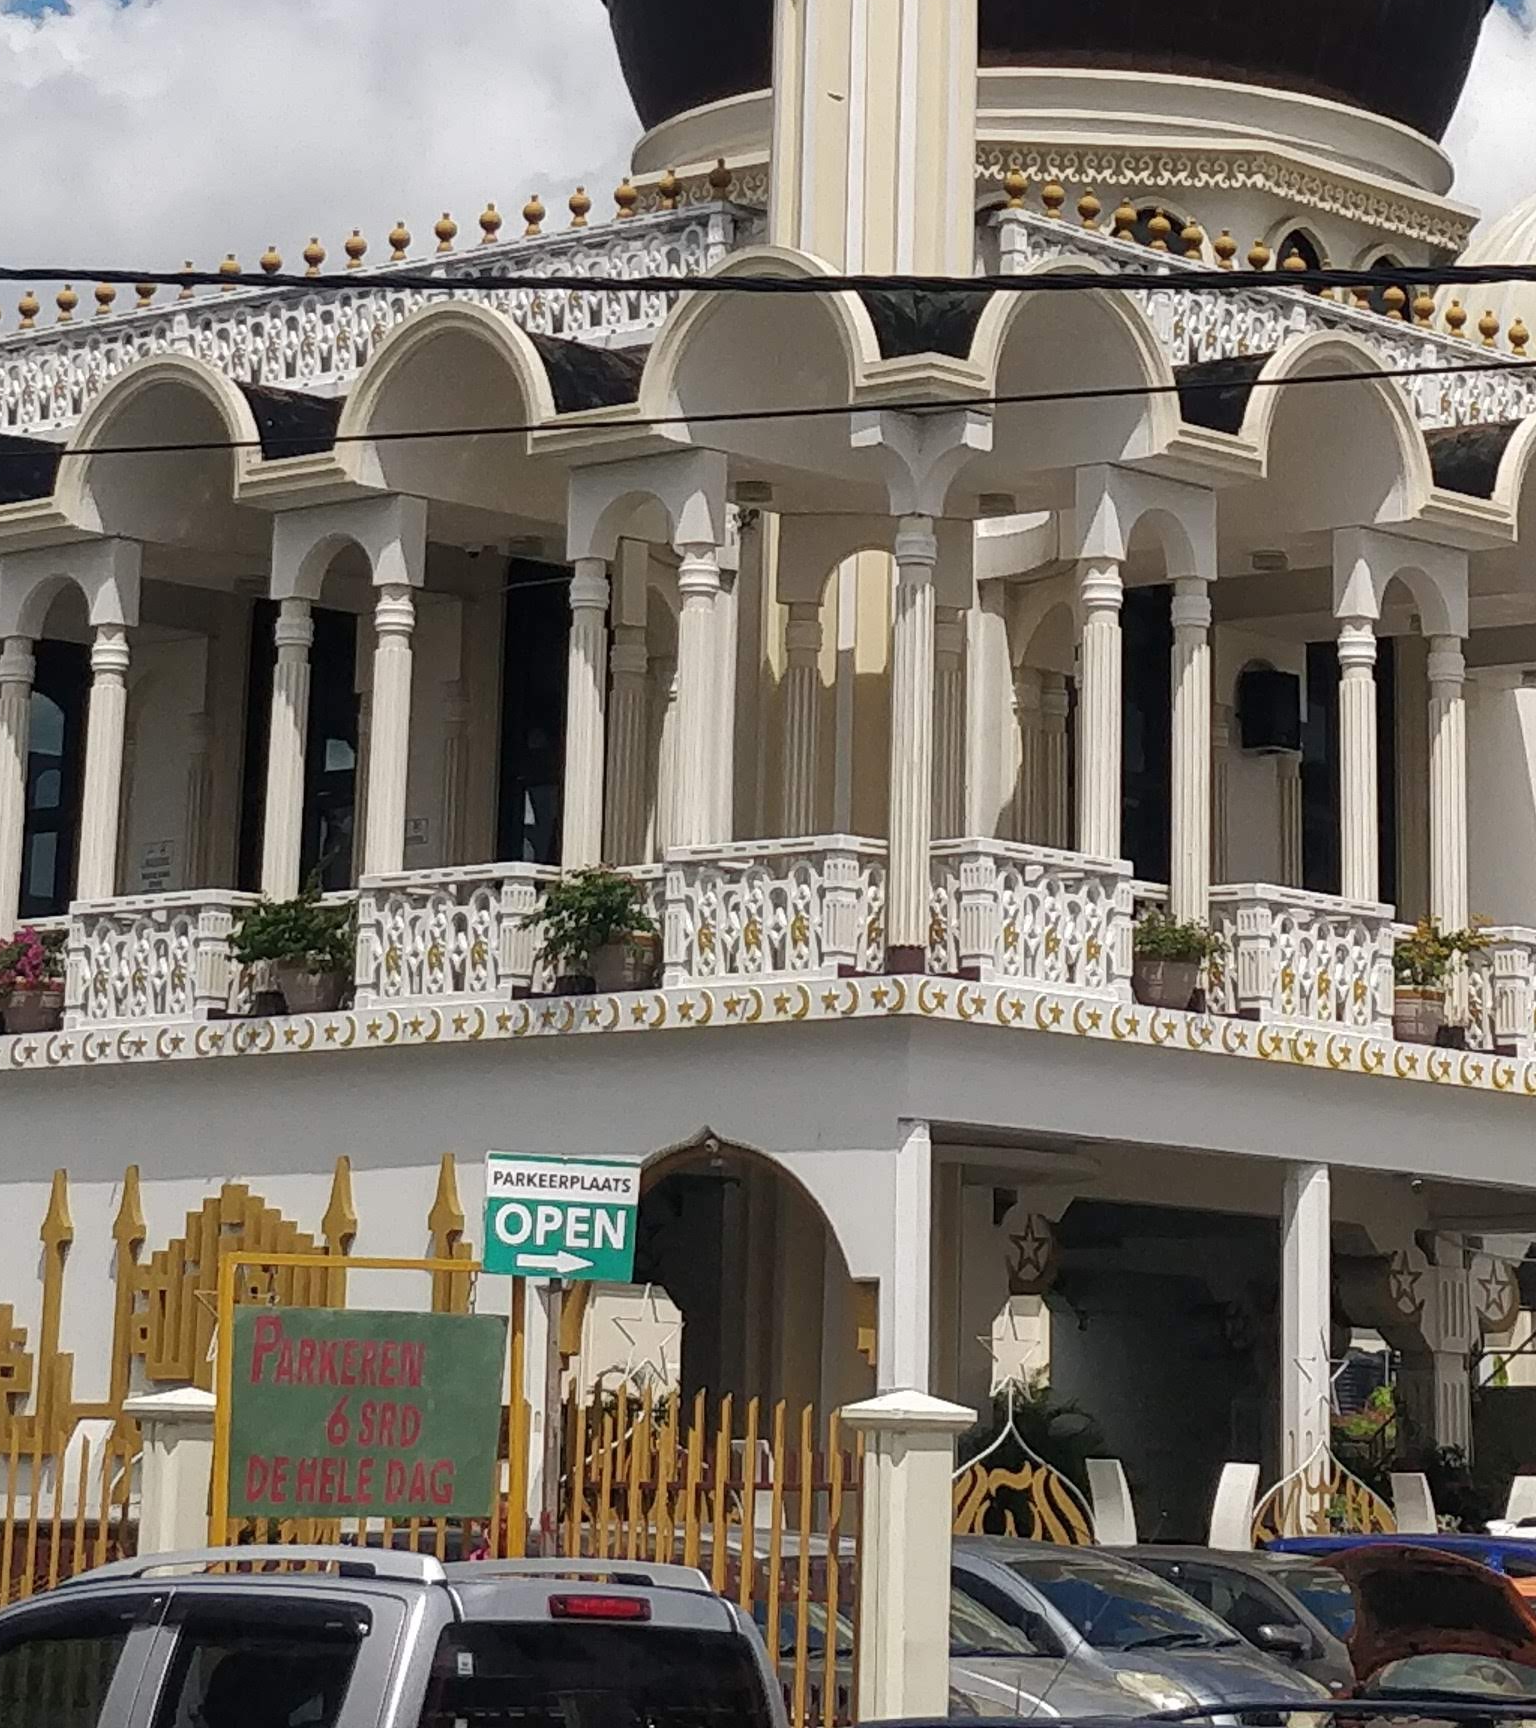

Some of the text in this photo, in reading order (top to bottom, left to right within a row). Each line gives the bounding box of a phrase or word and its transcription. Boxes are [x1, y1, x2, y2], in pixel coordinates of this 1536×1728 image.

[492, 1170, 632, 1193] PARKEERPLAATS
[495, 1202, 627, 1249] OPEN
[250, 1314, 426, 1388] PARKEREN
[326, 1394, 423, 1449] 6 SRD
[245, 1454, 455, 1505] DE HELE DAG
